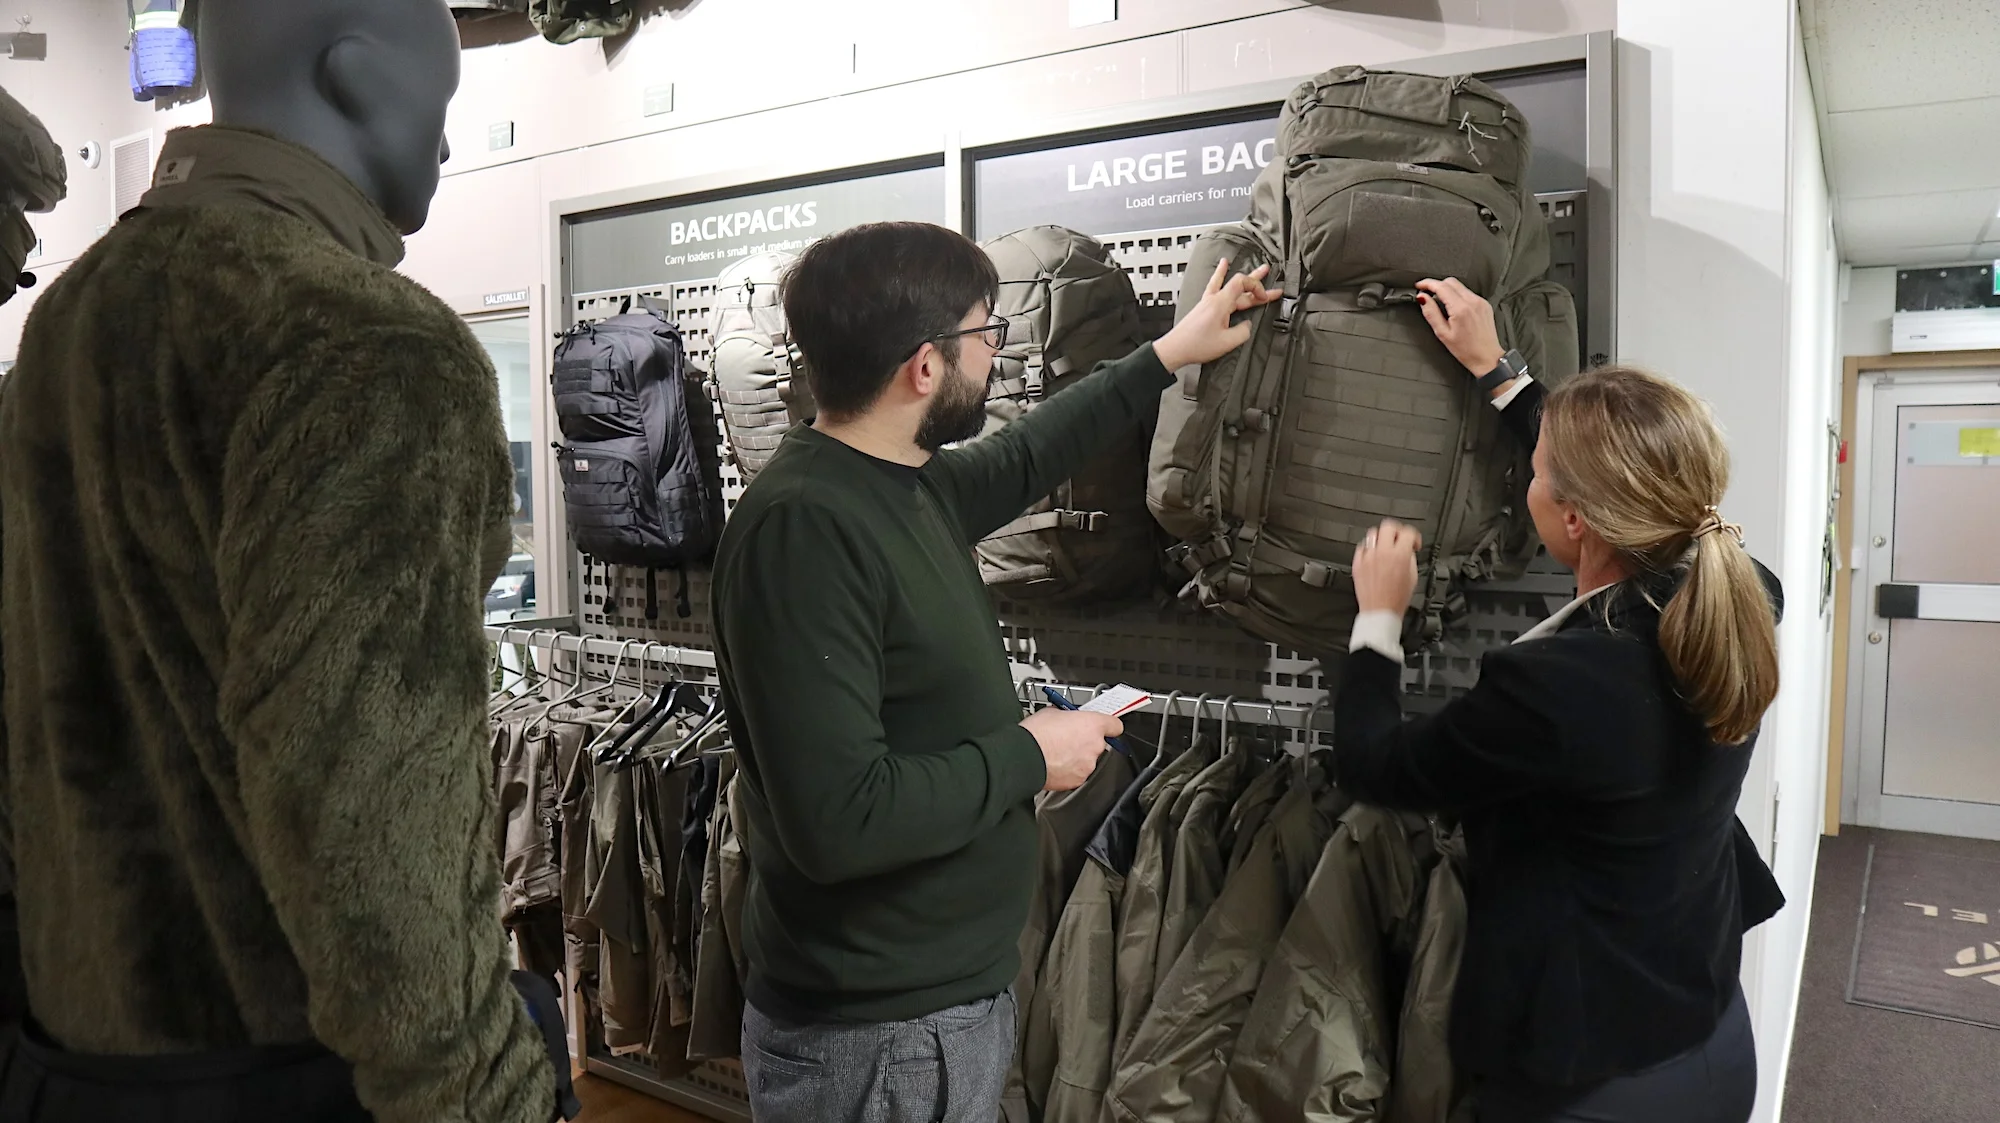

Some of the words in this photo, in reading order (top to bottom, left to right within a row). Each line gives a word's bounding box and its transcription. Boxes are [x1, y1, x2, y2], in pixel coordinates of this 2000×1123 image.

[1067, 149, 1187, 192] LARGE
[1125, 196, 1154, 209] Load
[1159, 190, 1203, 205] carriers
[1208, 188, 1227, 200] for
[670, 201, 817, 245] BACKPACKS
[664, 254, 685, 266] Carry
[687, 251, 715, 263] loaders
[717, 248, 725, 259] in
[727, 243, 748, 258] small
[750, 242, 766, 255] and
[768, 239, 803, 252] medium
